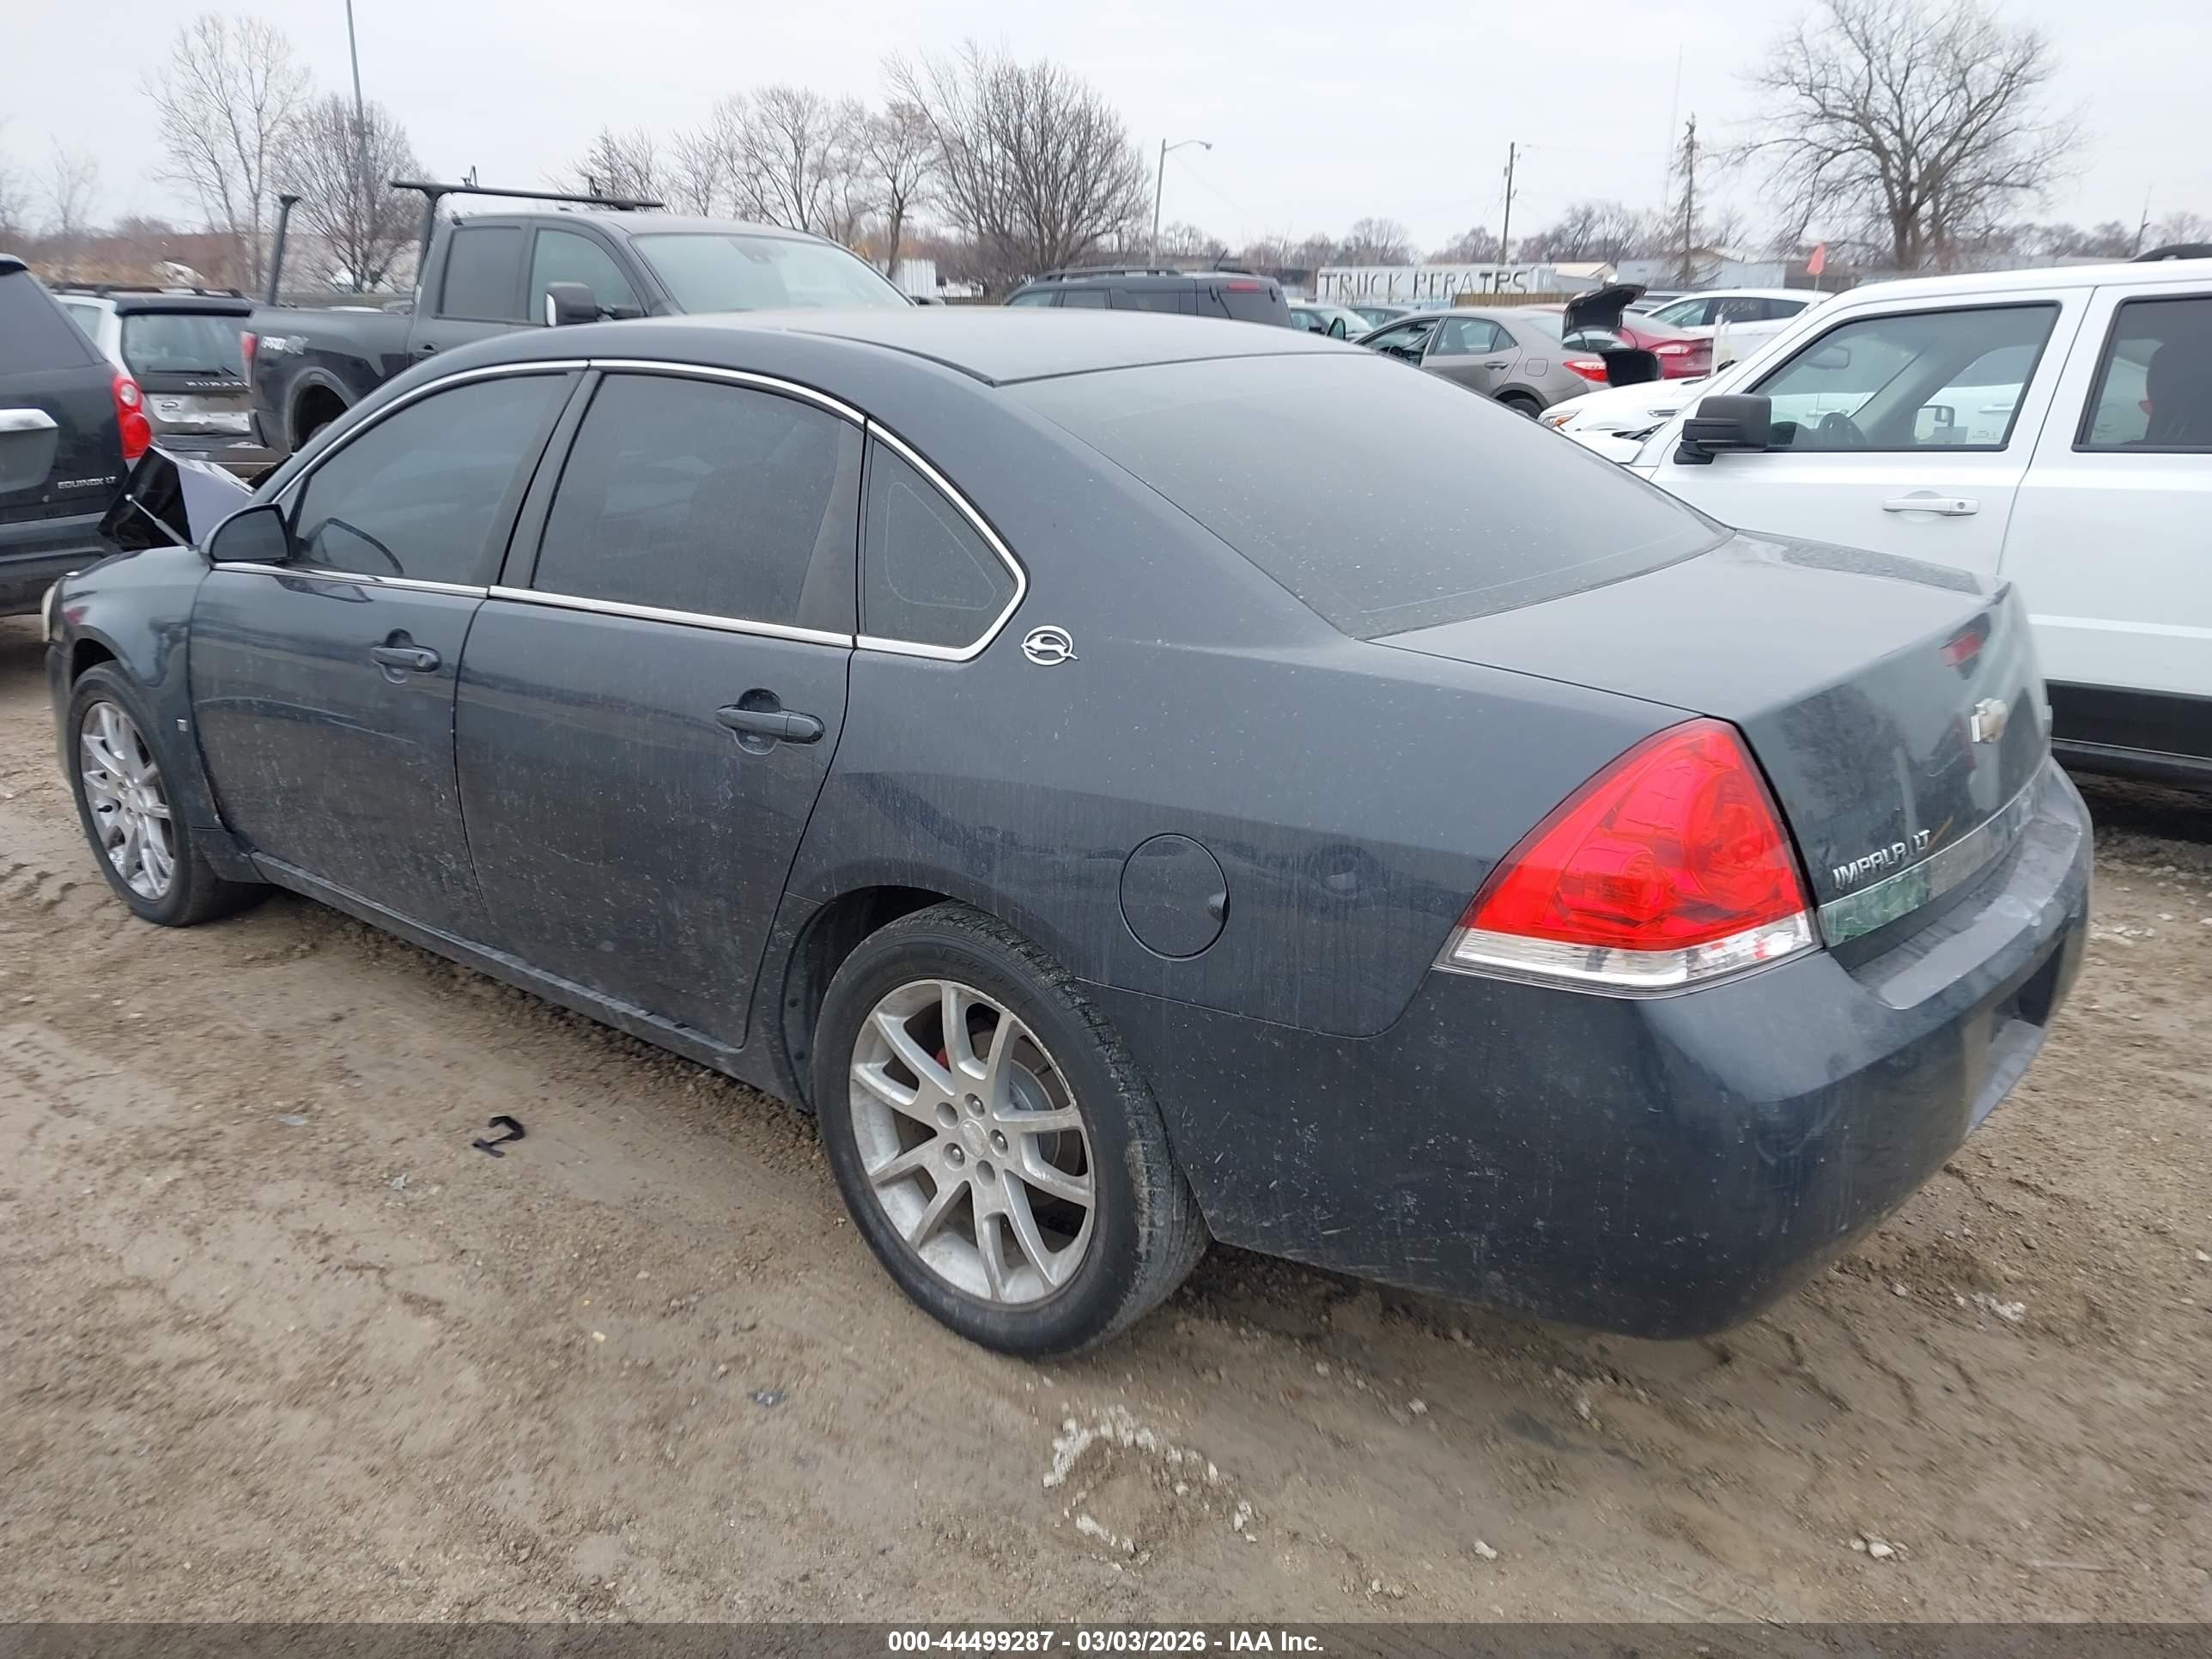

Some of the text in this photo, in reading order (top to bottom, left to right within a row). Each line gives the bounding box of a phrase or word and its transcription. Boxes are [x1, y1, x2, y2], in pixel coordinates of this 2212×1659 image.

[1319, 272, 1402, 301] TRUCK
[57, 476, 117, 489] EQUINOX LT
[1832, 830, 1930, 890] IMPALA LT
